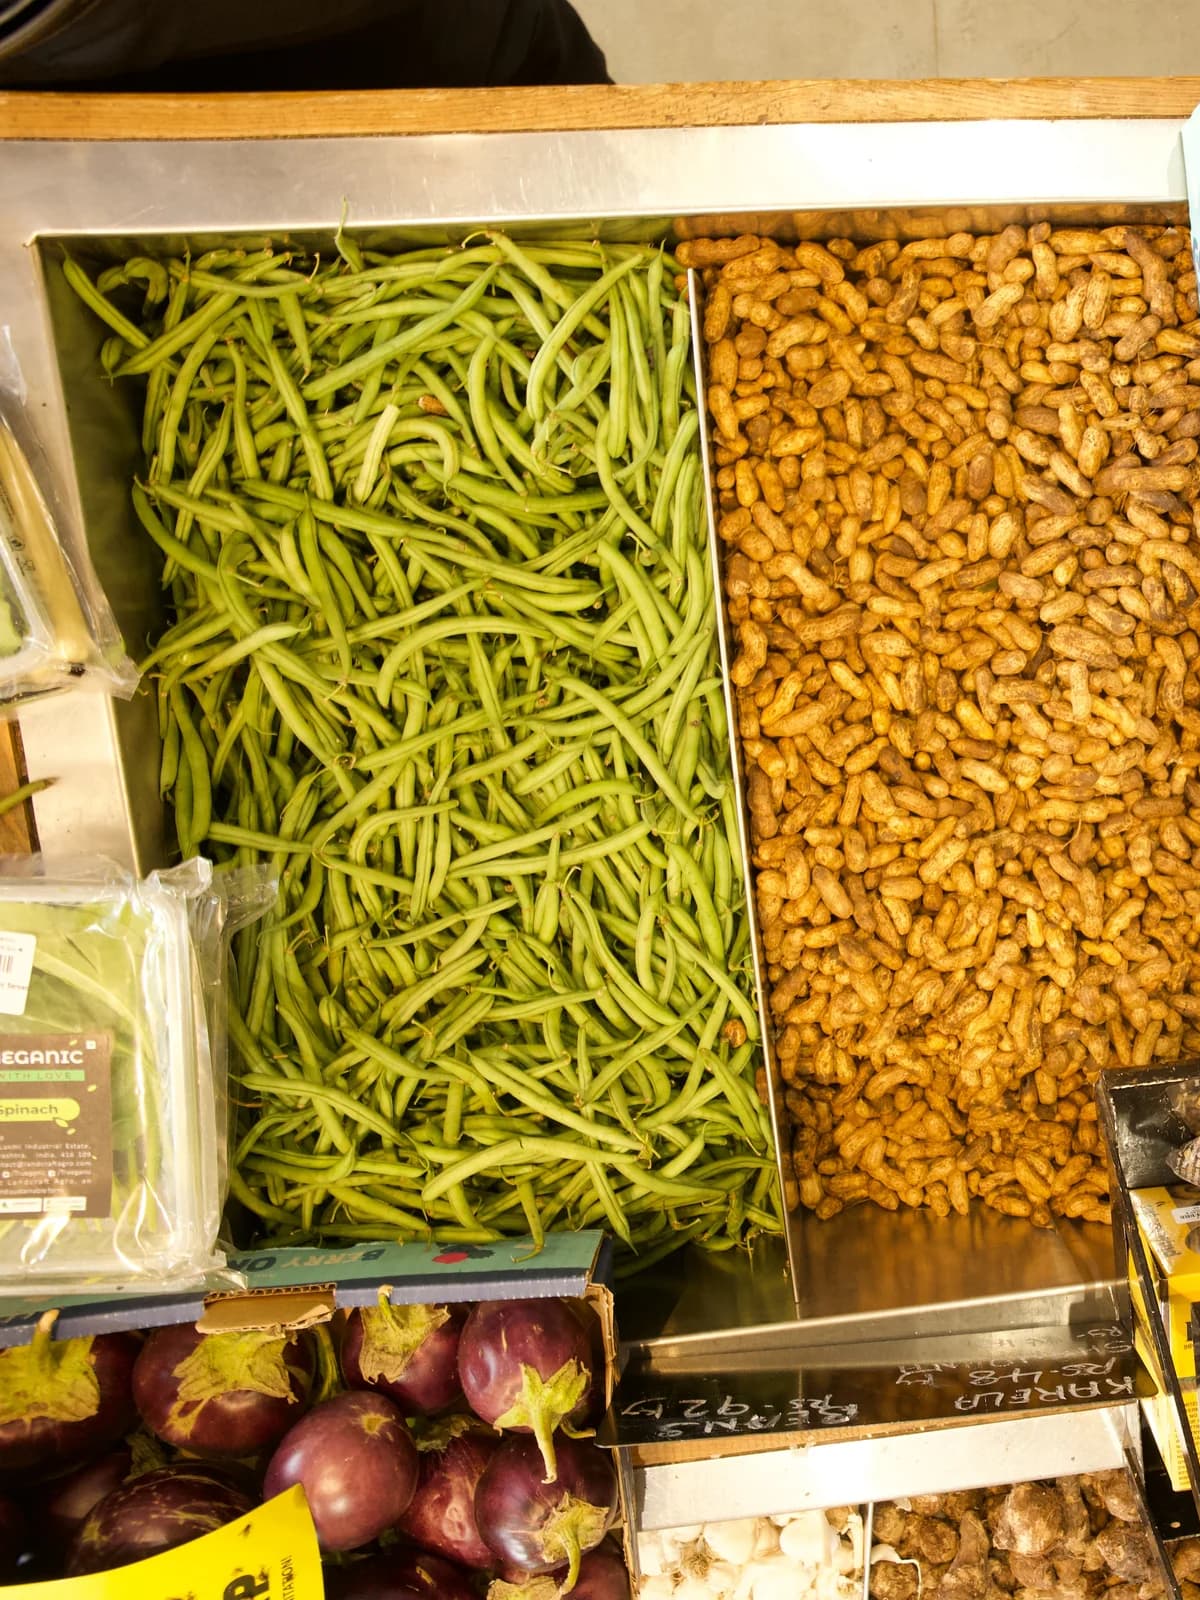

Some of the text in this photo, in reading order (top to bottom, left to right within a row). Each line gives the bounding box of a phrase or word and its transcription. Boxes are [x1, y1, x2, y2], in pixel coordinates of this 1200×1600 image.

[0, 1050, 84, 1064] EGANIC
[37, 1072, 72, 1080] LOVE
[0, 1104, 58, 1117] Spinach
[280, 1249, 386, 1270] BERRY
[954, 1376, 1135, 1411] KARELA
[654, 1403, 859, 1439] BEANS
